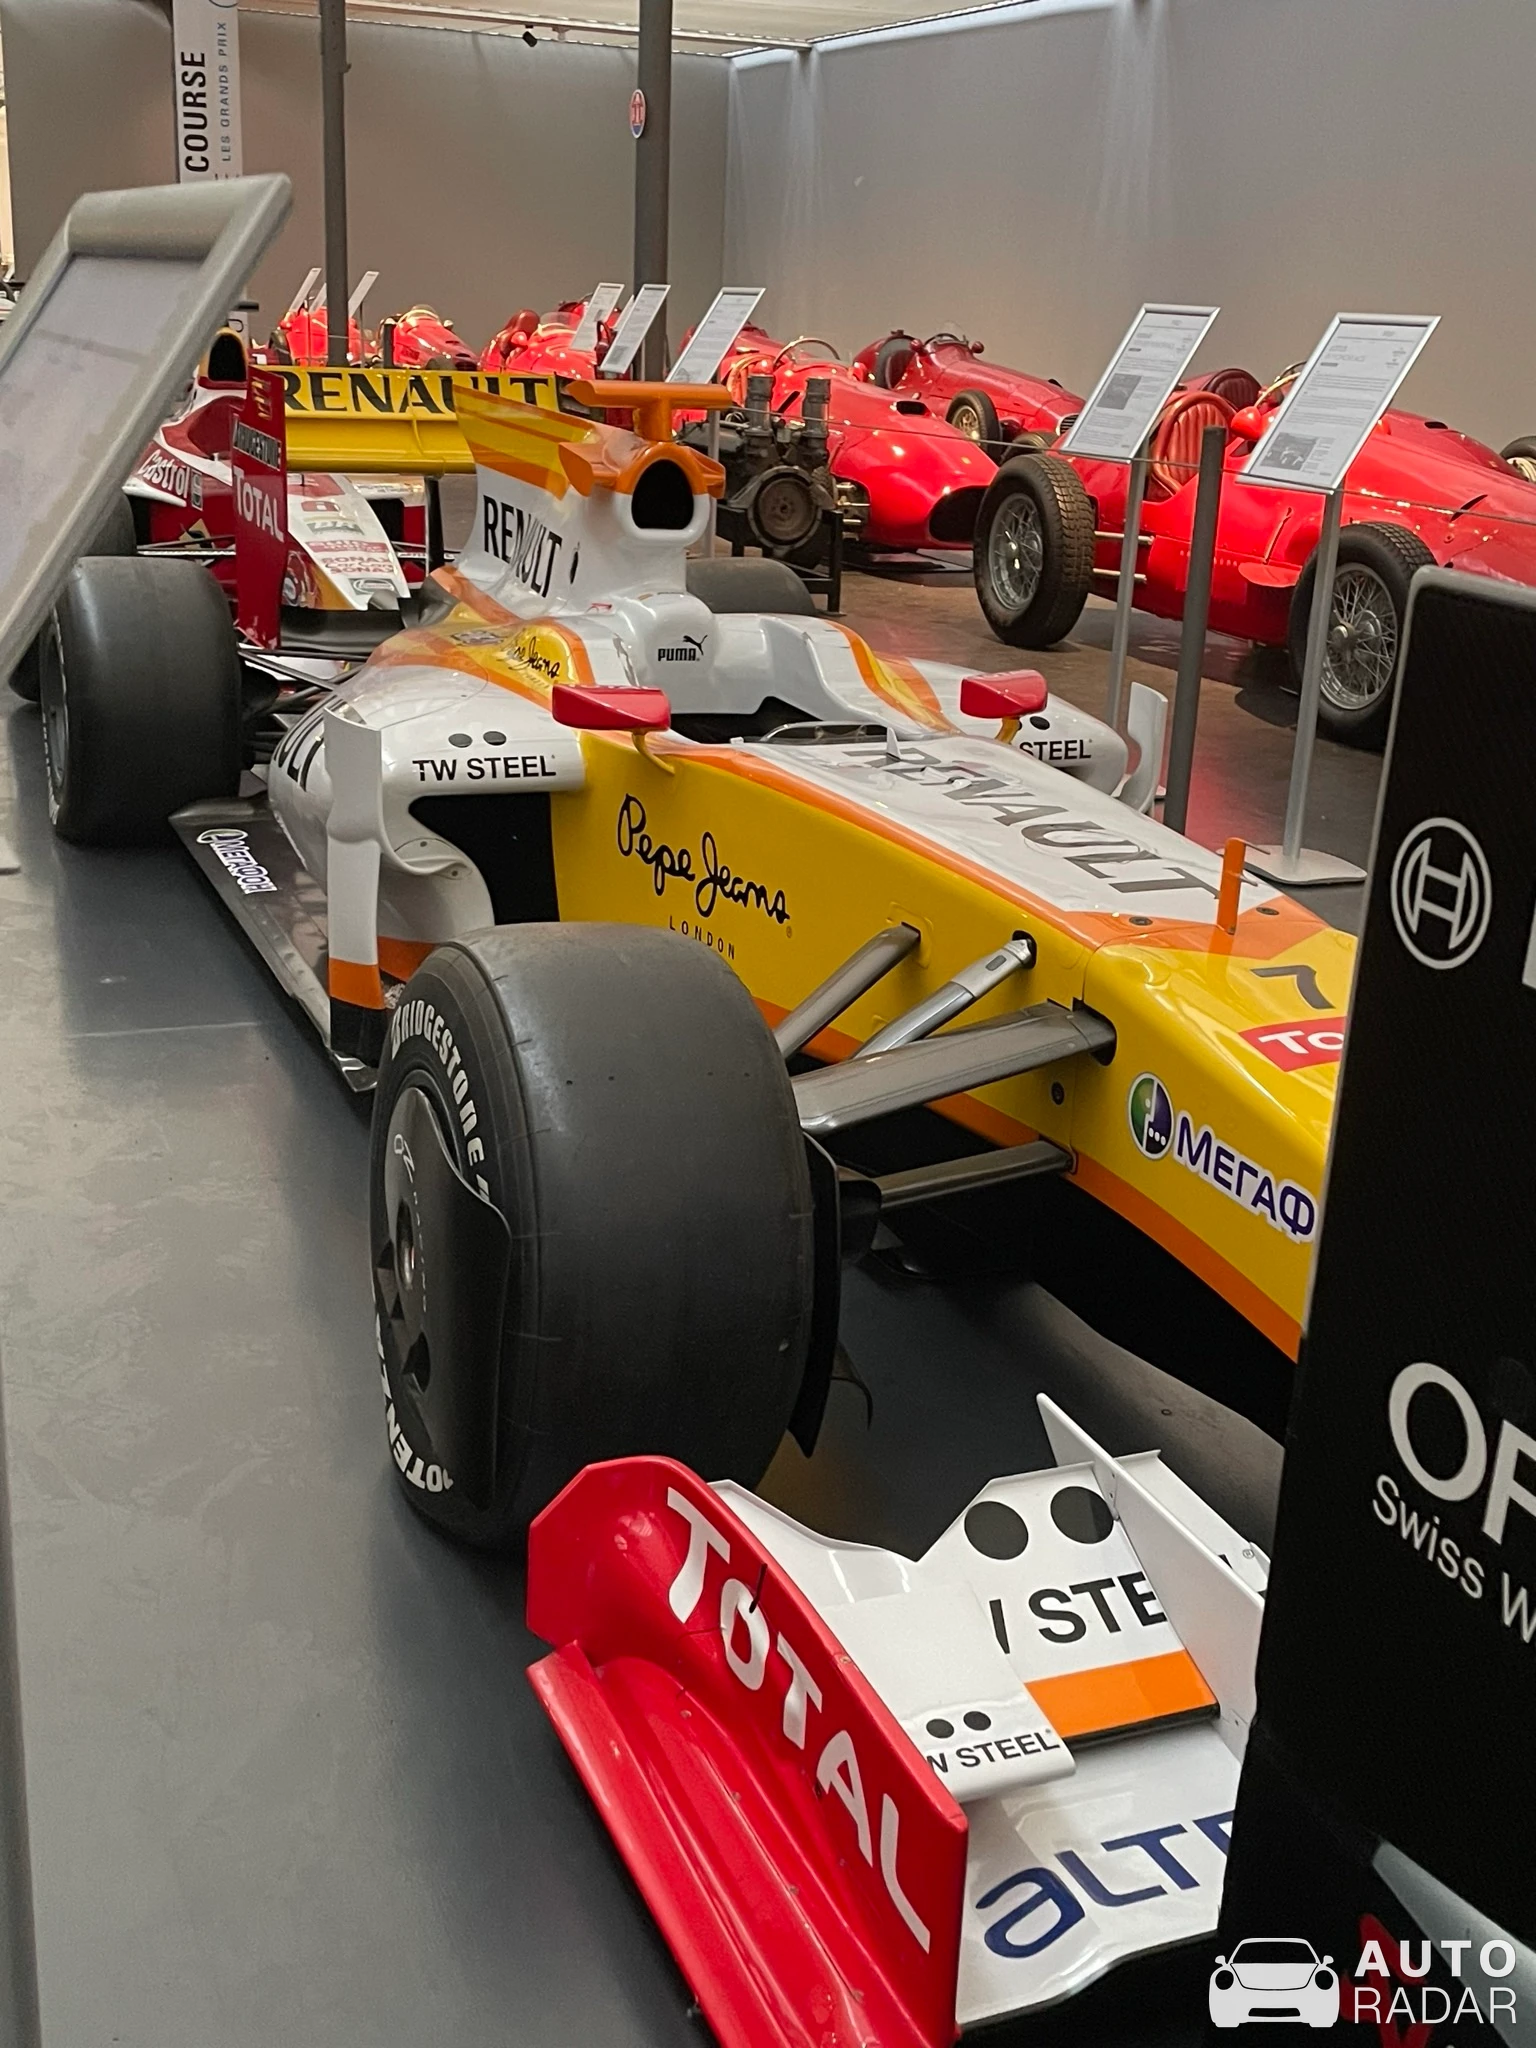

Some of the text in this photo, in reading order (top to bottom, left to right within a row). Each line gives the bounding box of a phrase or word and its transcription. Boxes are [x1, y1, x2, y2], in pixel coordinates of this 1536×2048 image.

[217, 22, 228, 56] PRIX
[181, 51, 210, 173] COURSE
[218, 64, 230, 128] GRANDS
[220, 135, 231, 162] LES
[137, 449, 190, 499] Castrol
[233, 465, 284, 542] TOTAL
[658, 649, 696, 662] PUMA
[412, 756, 556, 781] TW STEEL
[1019, 739, 1092, 761] STEEL
[842, 747, 1220, 900] RENAULT
[617, 793, 791, 924] Pepe Jeans
[668, 915, 735, 960] LONDON
[1250, 964, 1337, 1010] 7
[1176, 1116, 1316, 1236] МЕГАФ
[1372, 1474, 1485, 1600] Swiss
[667, 1487, 931, 1954] TOTAL
[955, 1732, 1061, 1768] STEEL
